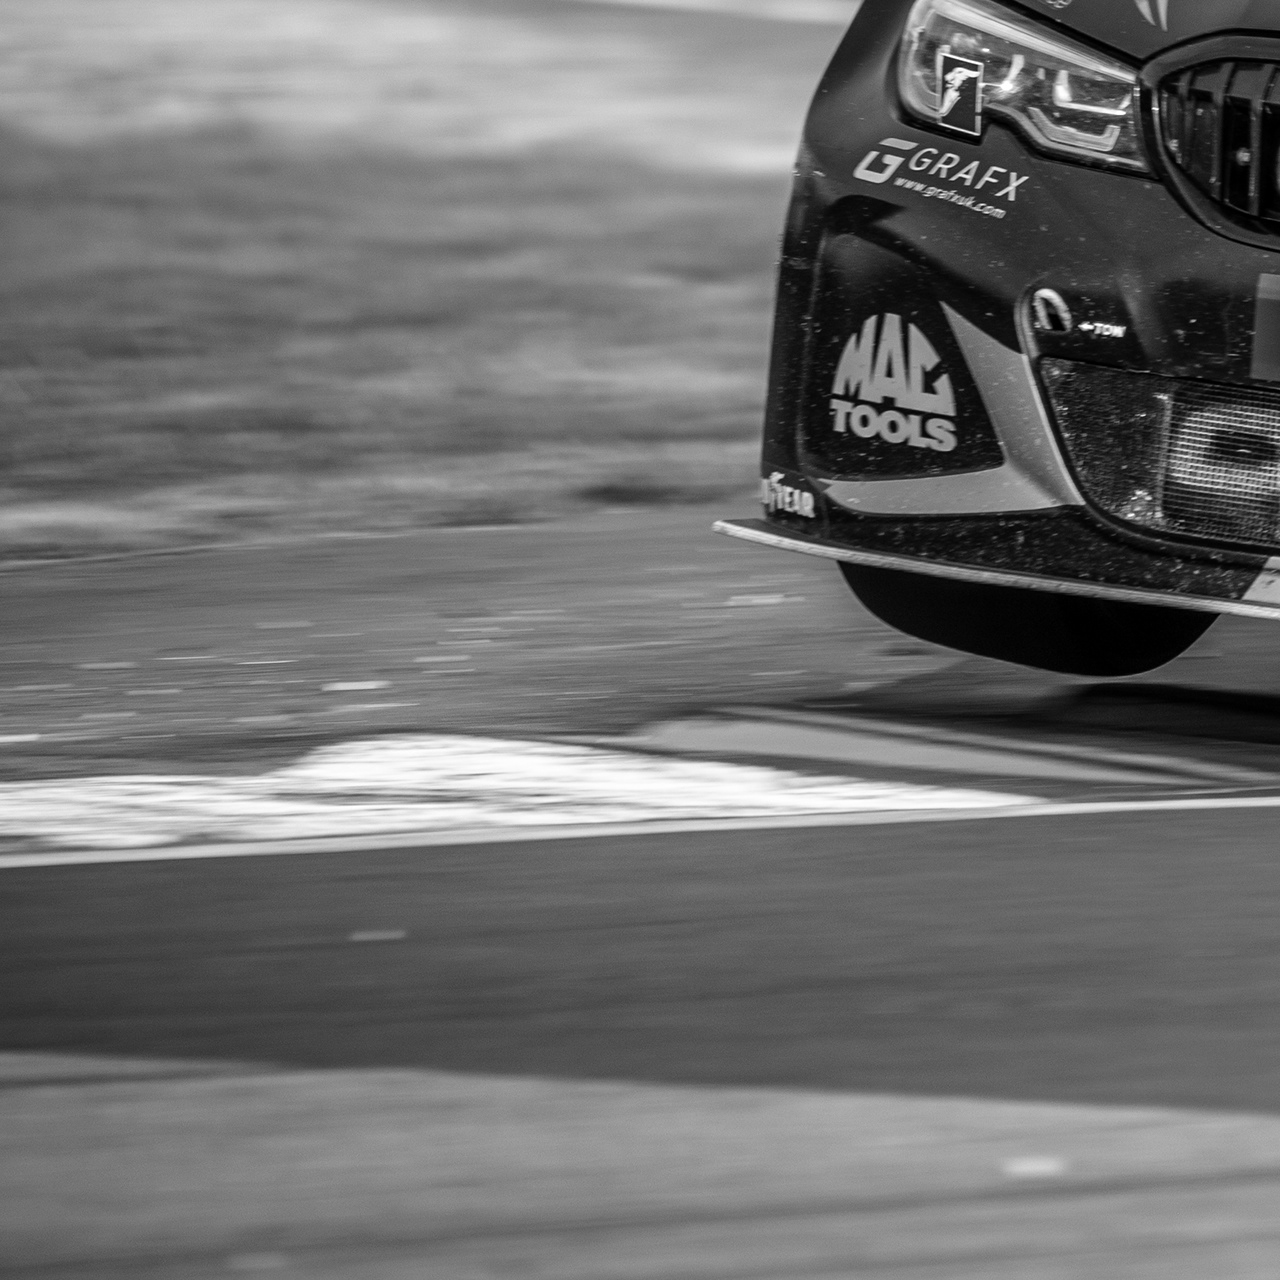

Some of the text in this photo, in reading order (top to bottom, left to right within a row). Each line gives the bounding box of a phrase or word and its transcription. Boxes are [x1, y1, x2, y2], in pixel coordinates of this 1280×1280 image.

[908, 147, 1030, 202] GRAFX
[832, 312, 957, 417] MAC
[828, 399, 958, 452] TOOLS
